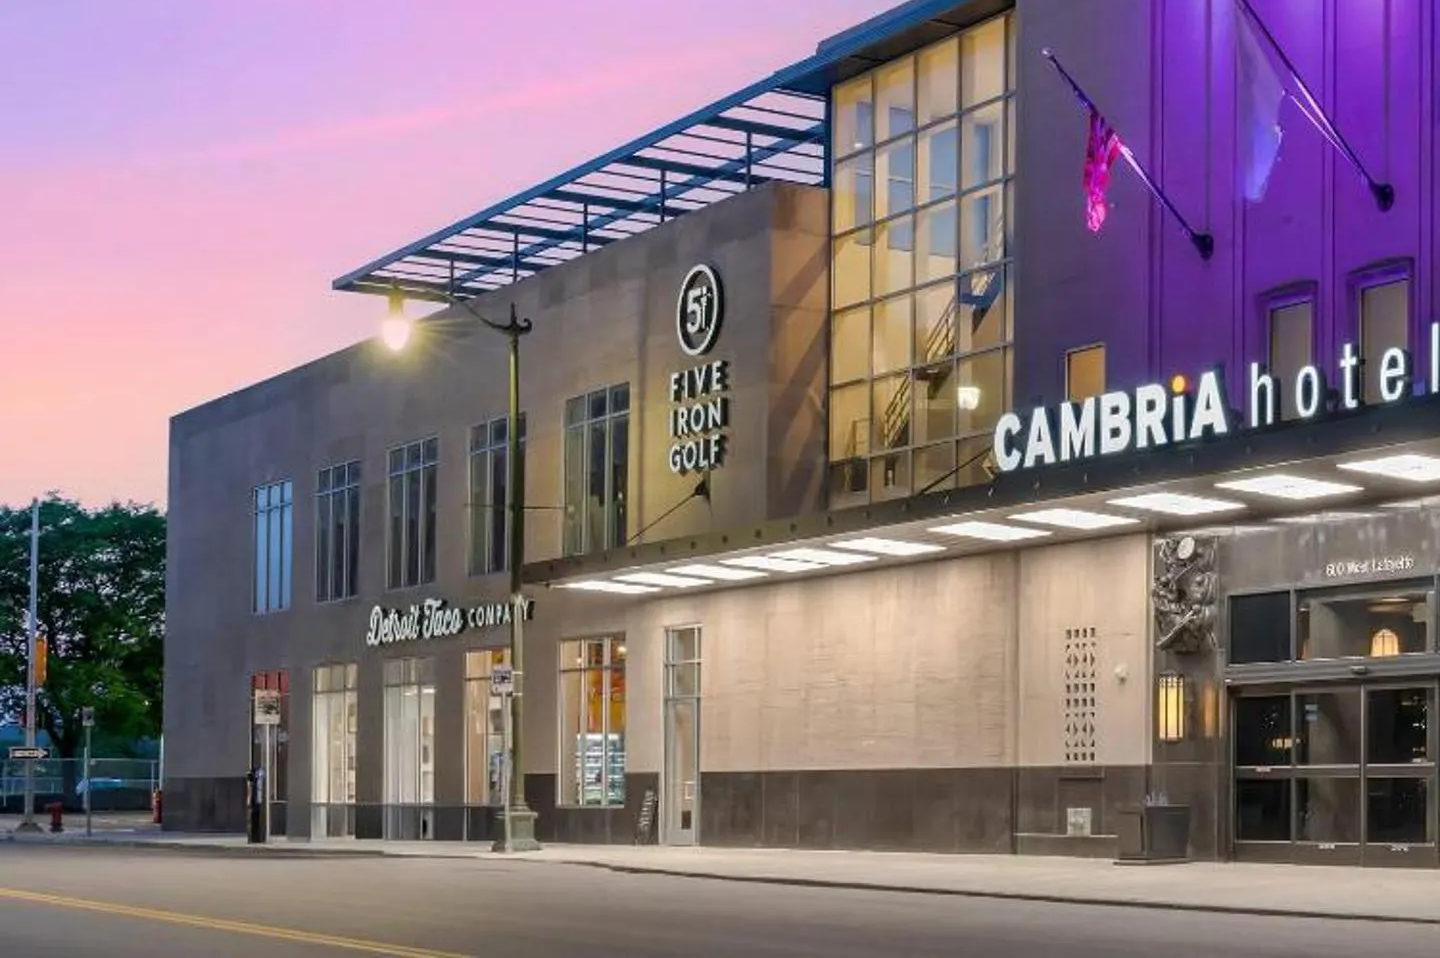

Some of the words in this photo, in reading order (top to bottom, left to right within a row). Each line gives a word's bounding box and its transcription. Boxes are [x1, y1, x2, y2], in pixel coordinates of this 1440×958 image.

[670, 360, 723, 402] FIVE
[669, 397, 722, 436] IRON
[669, 433, 720, 474] GOLF
[366, 605, 420, 646] Detroit
[422, 598, 464, 640] Taco
[467, 598, 529, 628] COMPAY
